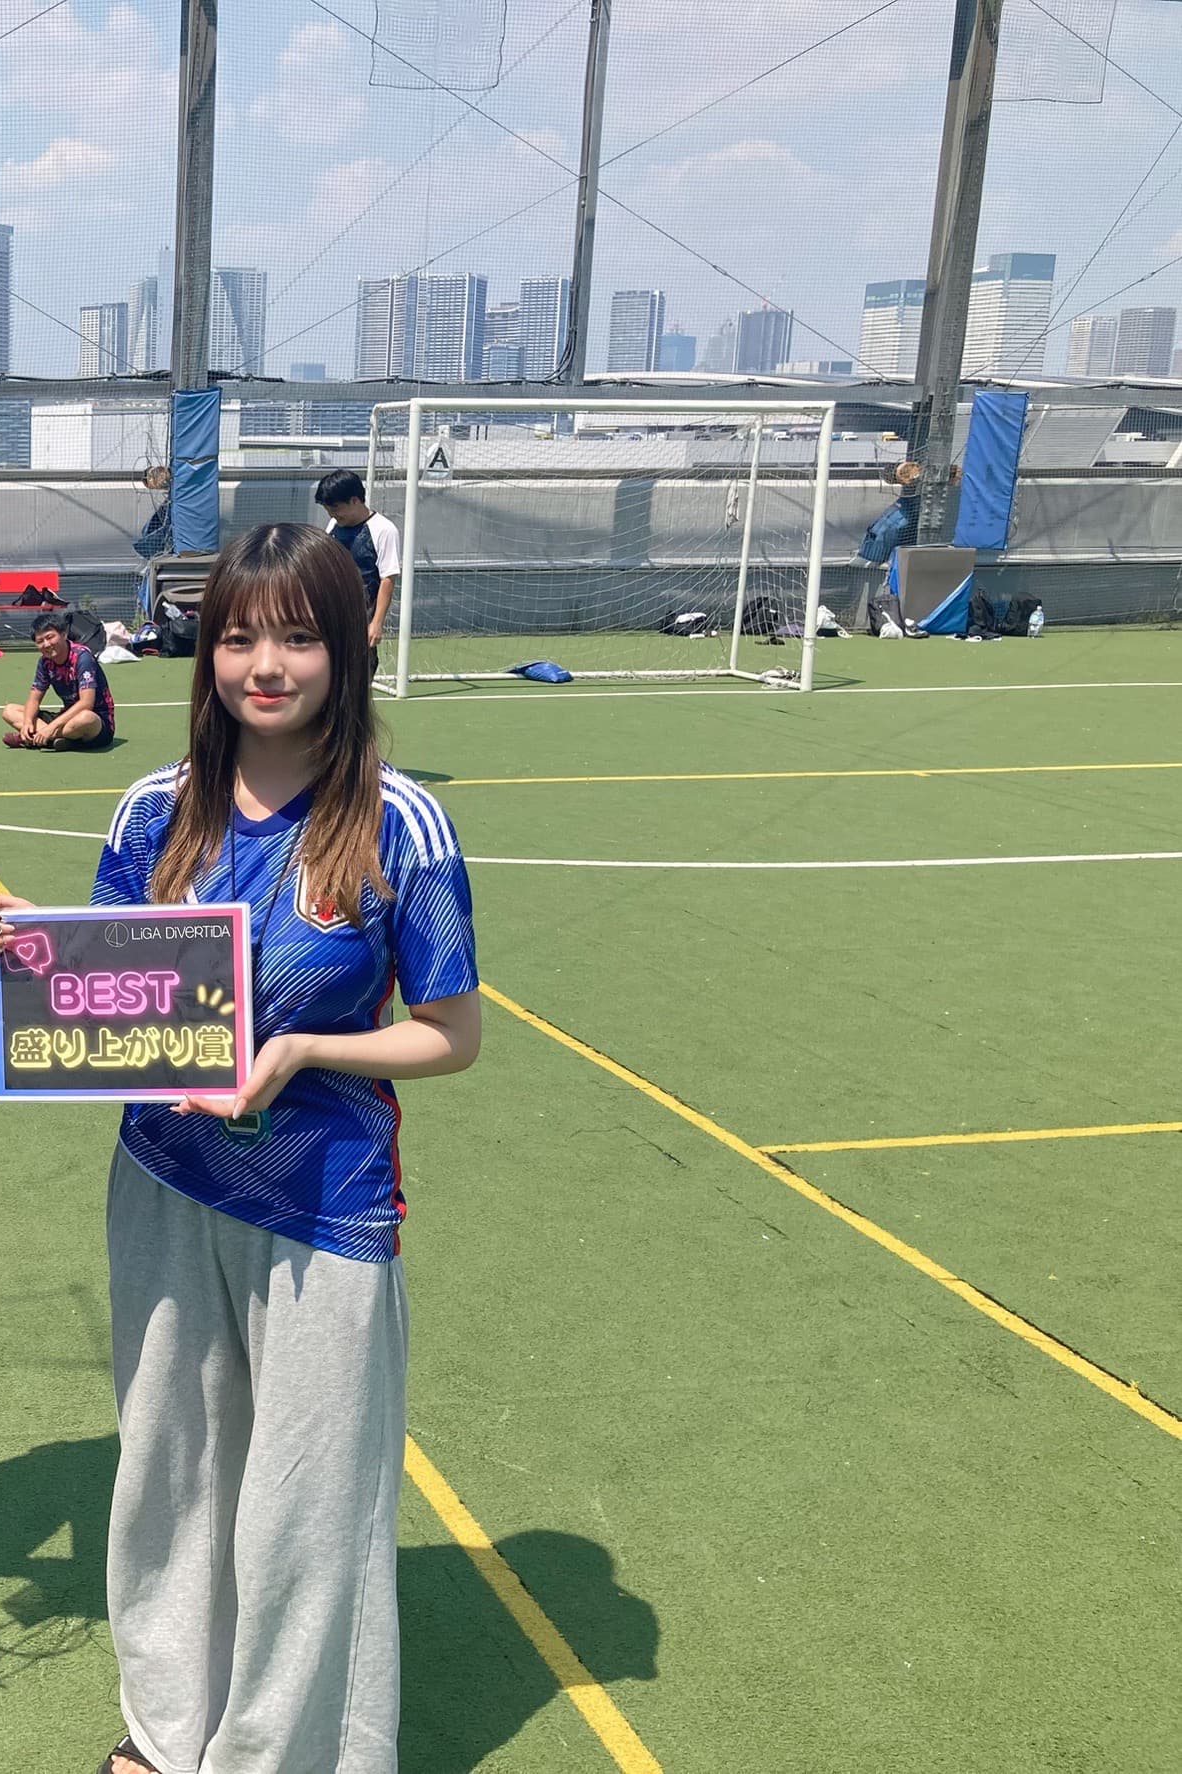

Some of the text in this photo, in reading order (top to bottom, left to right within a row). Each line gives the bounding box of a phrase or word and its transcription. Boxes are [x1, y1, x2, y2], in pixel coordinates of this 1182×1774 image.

[428, 446, 450, 469] A
[50, 970, 180, 1016] BEST
[9, 1025, 234, 1069] 盛り上がり賞
